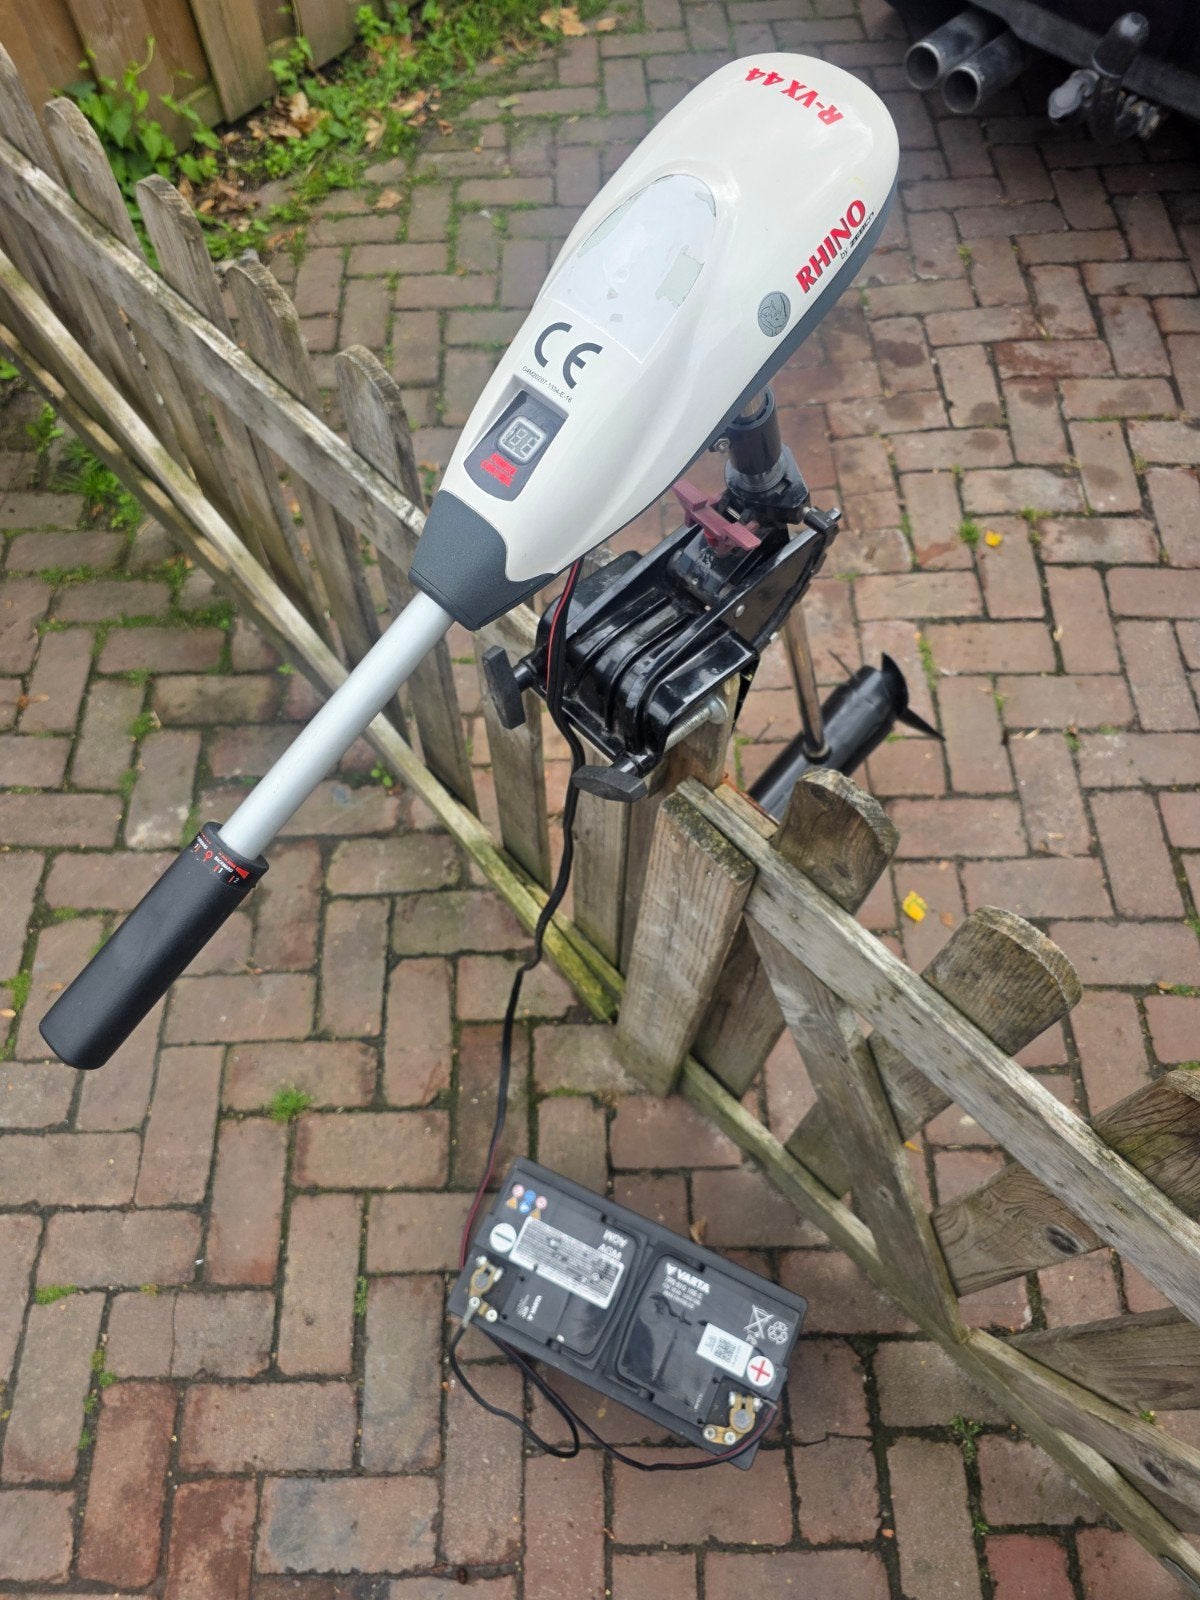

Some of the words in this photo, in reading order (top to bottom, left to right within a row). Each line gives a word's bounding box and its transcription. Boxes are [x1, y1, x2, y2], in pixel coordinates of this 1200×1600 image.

[795, 199, 866, 294] RHINO
[534, 321, 603, 390] CE
[677, 1268, 710, 1295] VARTA
